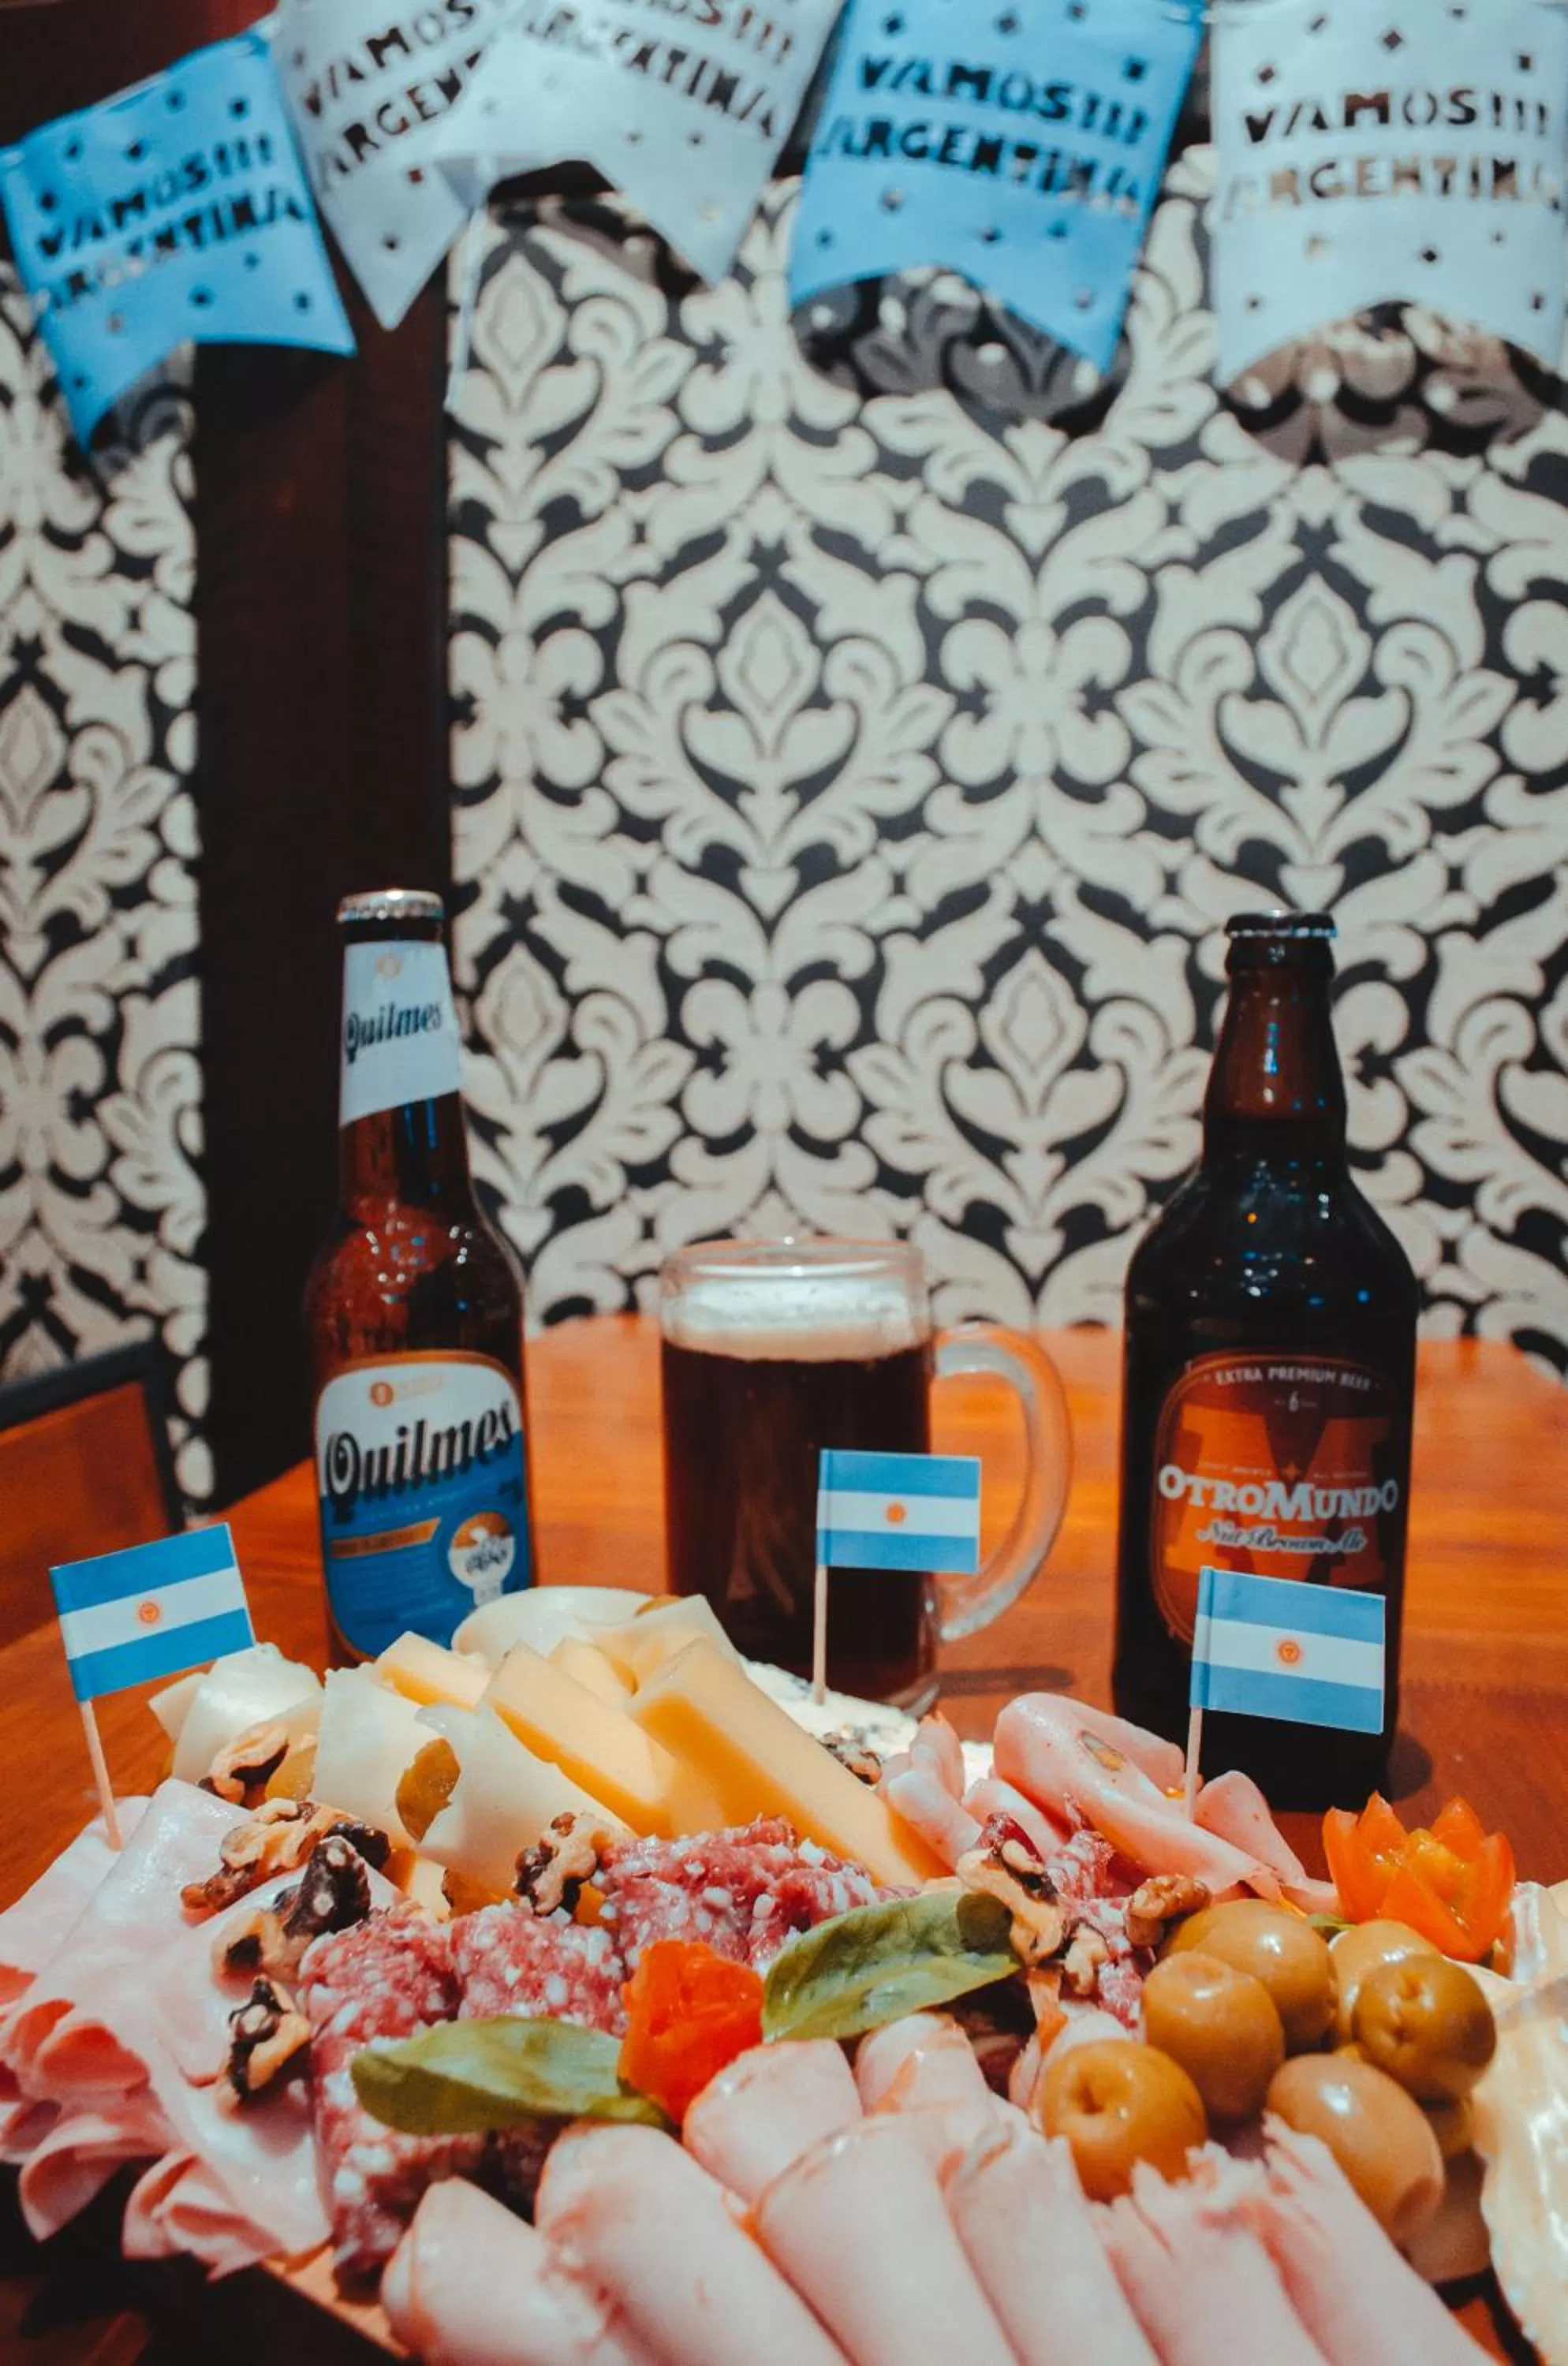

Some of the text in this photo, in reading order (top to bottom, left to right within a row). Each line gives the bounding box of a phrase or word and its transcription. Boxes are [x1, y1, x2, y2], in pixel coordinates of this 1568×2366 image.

[861, 52, 1148, 145] VAMOS!!!
[1244, 88, 1547, 144] VAMOS!!!
[37, 131, 272, 259] VAMOS!!!
[816, 117, 1142, 215] ARGENTINA
[345, 1002, 443, 1065] Quilmes
[1215, 1367, 1262, 1386] EXTRA
[1268, 1366, 1336, 1384] PREMIUM
[324, 1398, 513, 1524] Quilmes
